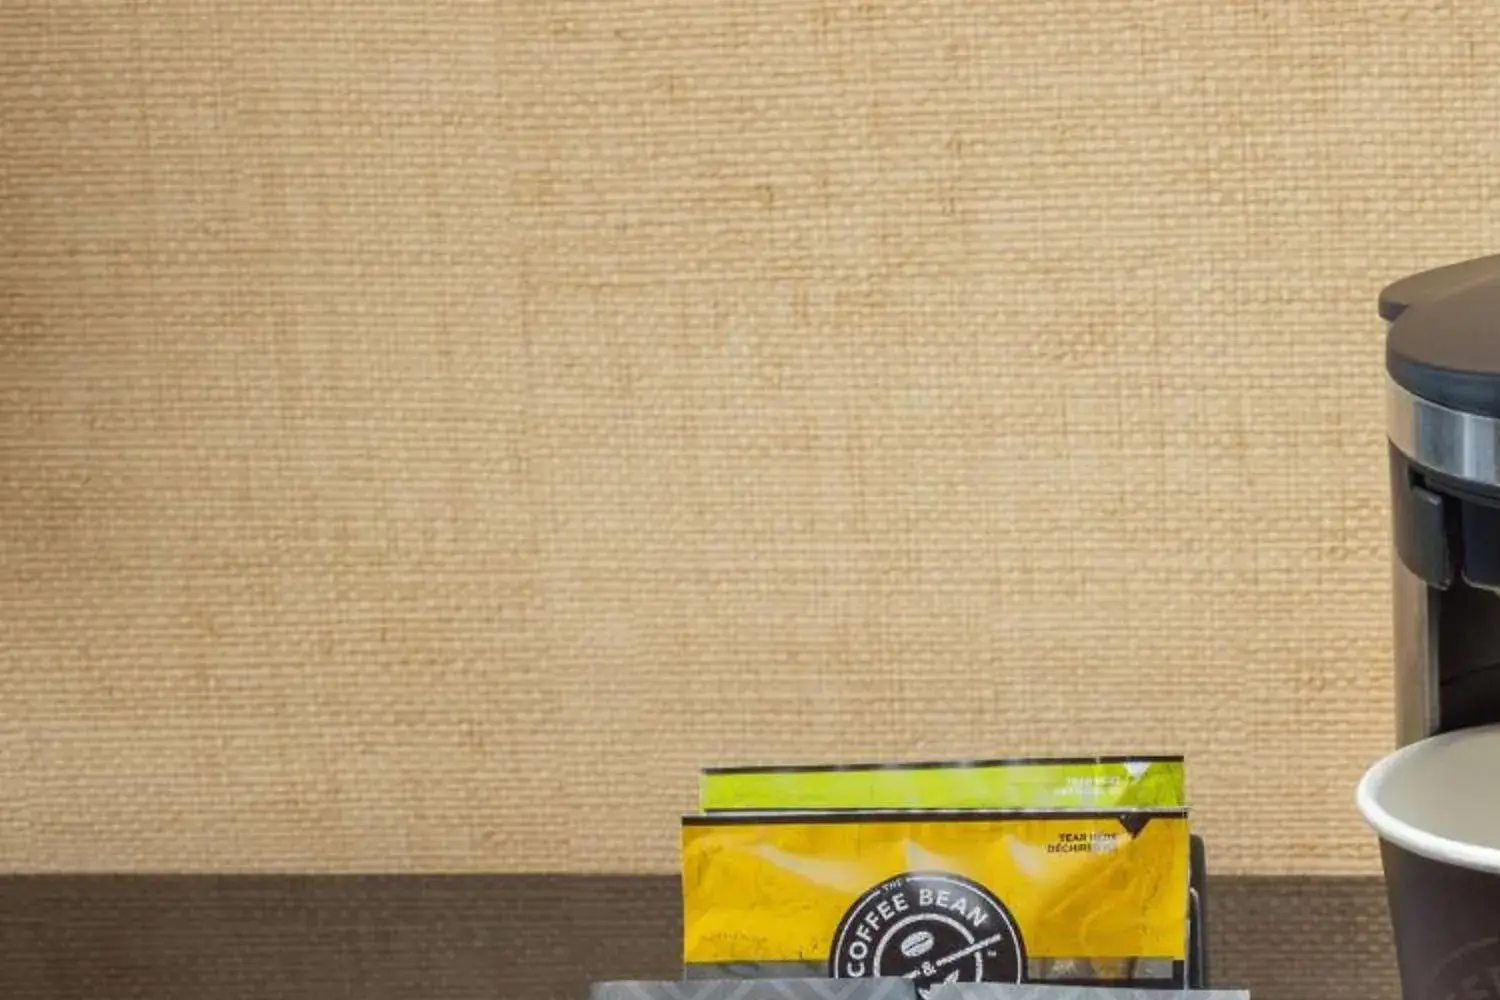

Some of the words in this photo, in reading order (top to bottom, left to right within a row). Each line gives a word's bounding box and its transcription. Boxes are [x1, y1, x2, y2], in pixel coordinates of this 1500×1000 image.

[847, 893, 909, 978] COFFEE
[919, 888, 989, 928] BEAN
[921, 960, 938, 977] &
